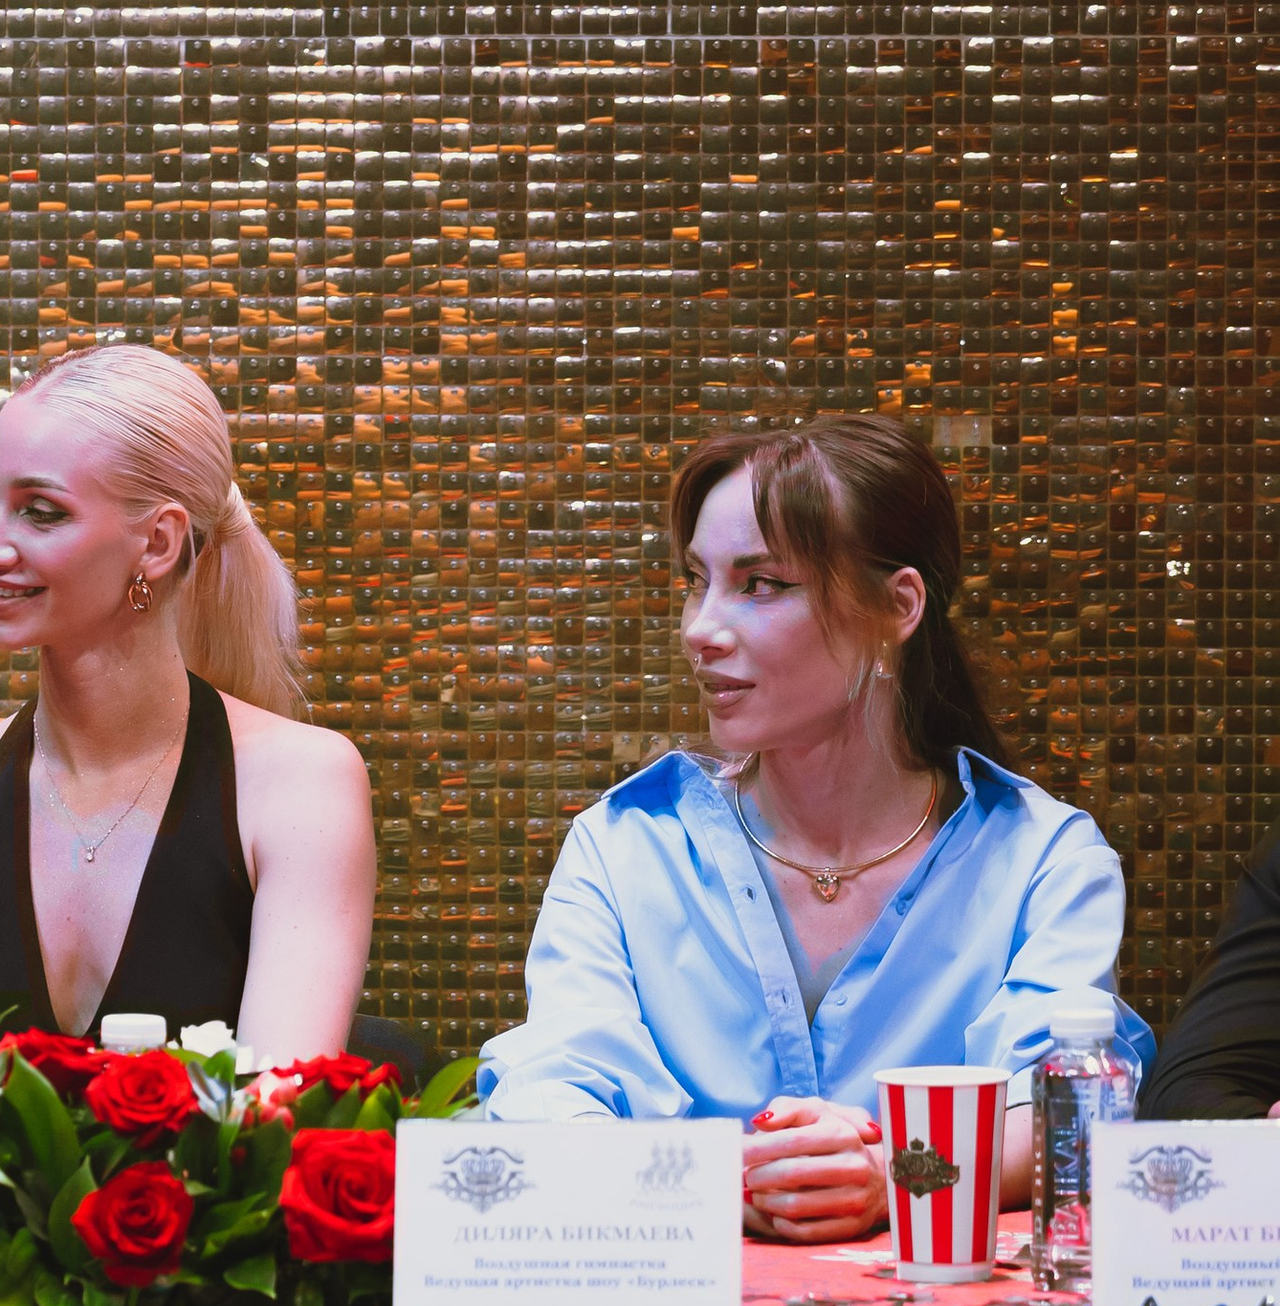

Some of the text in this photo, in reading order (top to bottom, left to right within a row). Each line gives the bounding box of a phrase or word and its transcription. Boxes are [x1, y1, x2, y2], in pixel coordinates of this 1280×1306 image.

[453, 1225, 695, 1244] ДИЛЯРА БИКМАЕВА
[1171, 1226, 1253, 1243] МАРАТ
[424, 1274, 499, 1289] Ведущая
[504, 1276, 581, 1290] артистка
[586, 1277, 621, 1290] шоу
[1132, 1277, 1275, 1291] Ведущий артист
